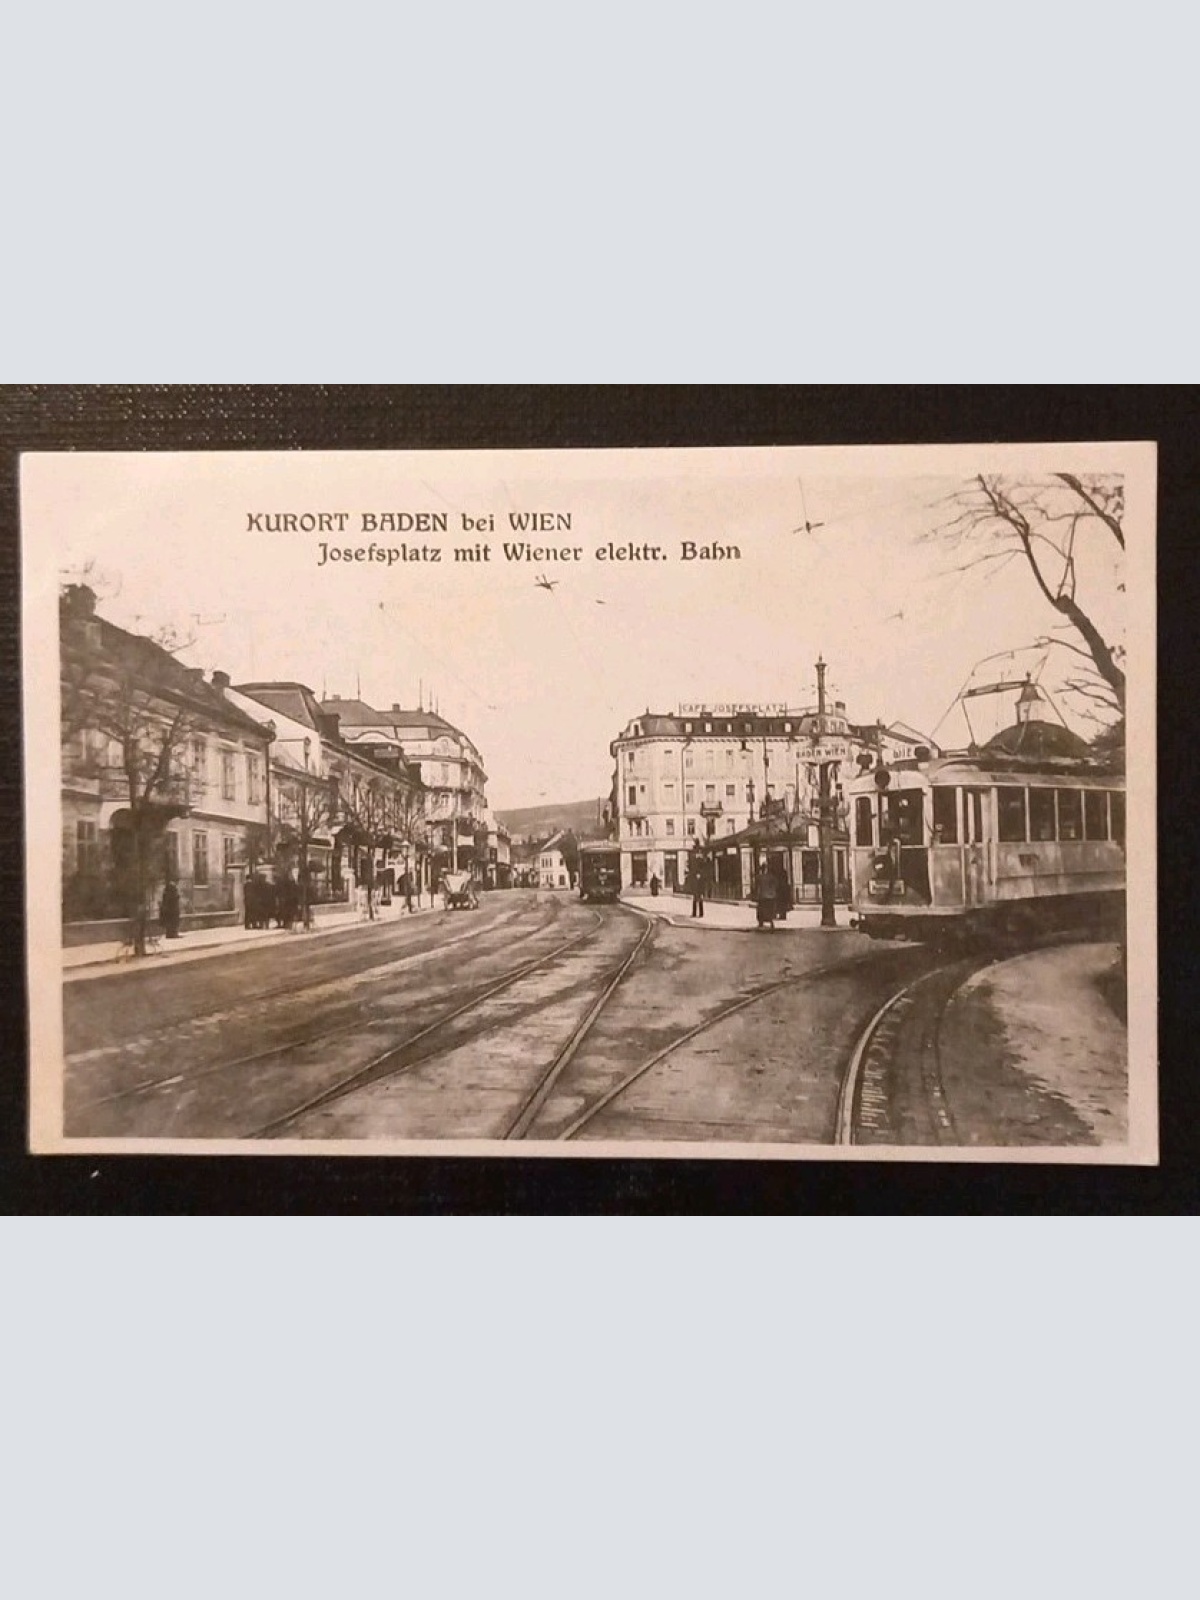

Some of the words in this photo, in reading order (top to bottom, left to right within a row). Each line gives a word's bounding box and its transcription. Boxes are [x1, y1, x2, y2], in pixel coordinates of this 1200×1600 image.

[247, 513, 349, 533] KURORT
[361, 512, 448, 532] BADEN
[461, 512, 495, 532] bei
[508, 512, 572, 531] WIEN
[317, 542, 442, 567] Josefsplatz
[453, 543, 491, 562] mit
[503, 542, 583, 562] Wiener
[595, 542, 667, 561] elektr.
[680, 541, 741, 561] Bahn
[714, 703, 785, 713] JOSEFSPLATZ
